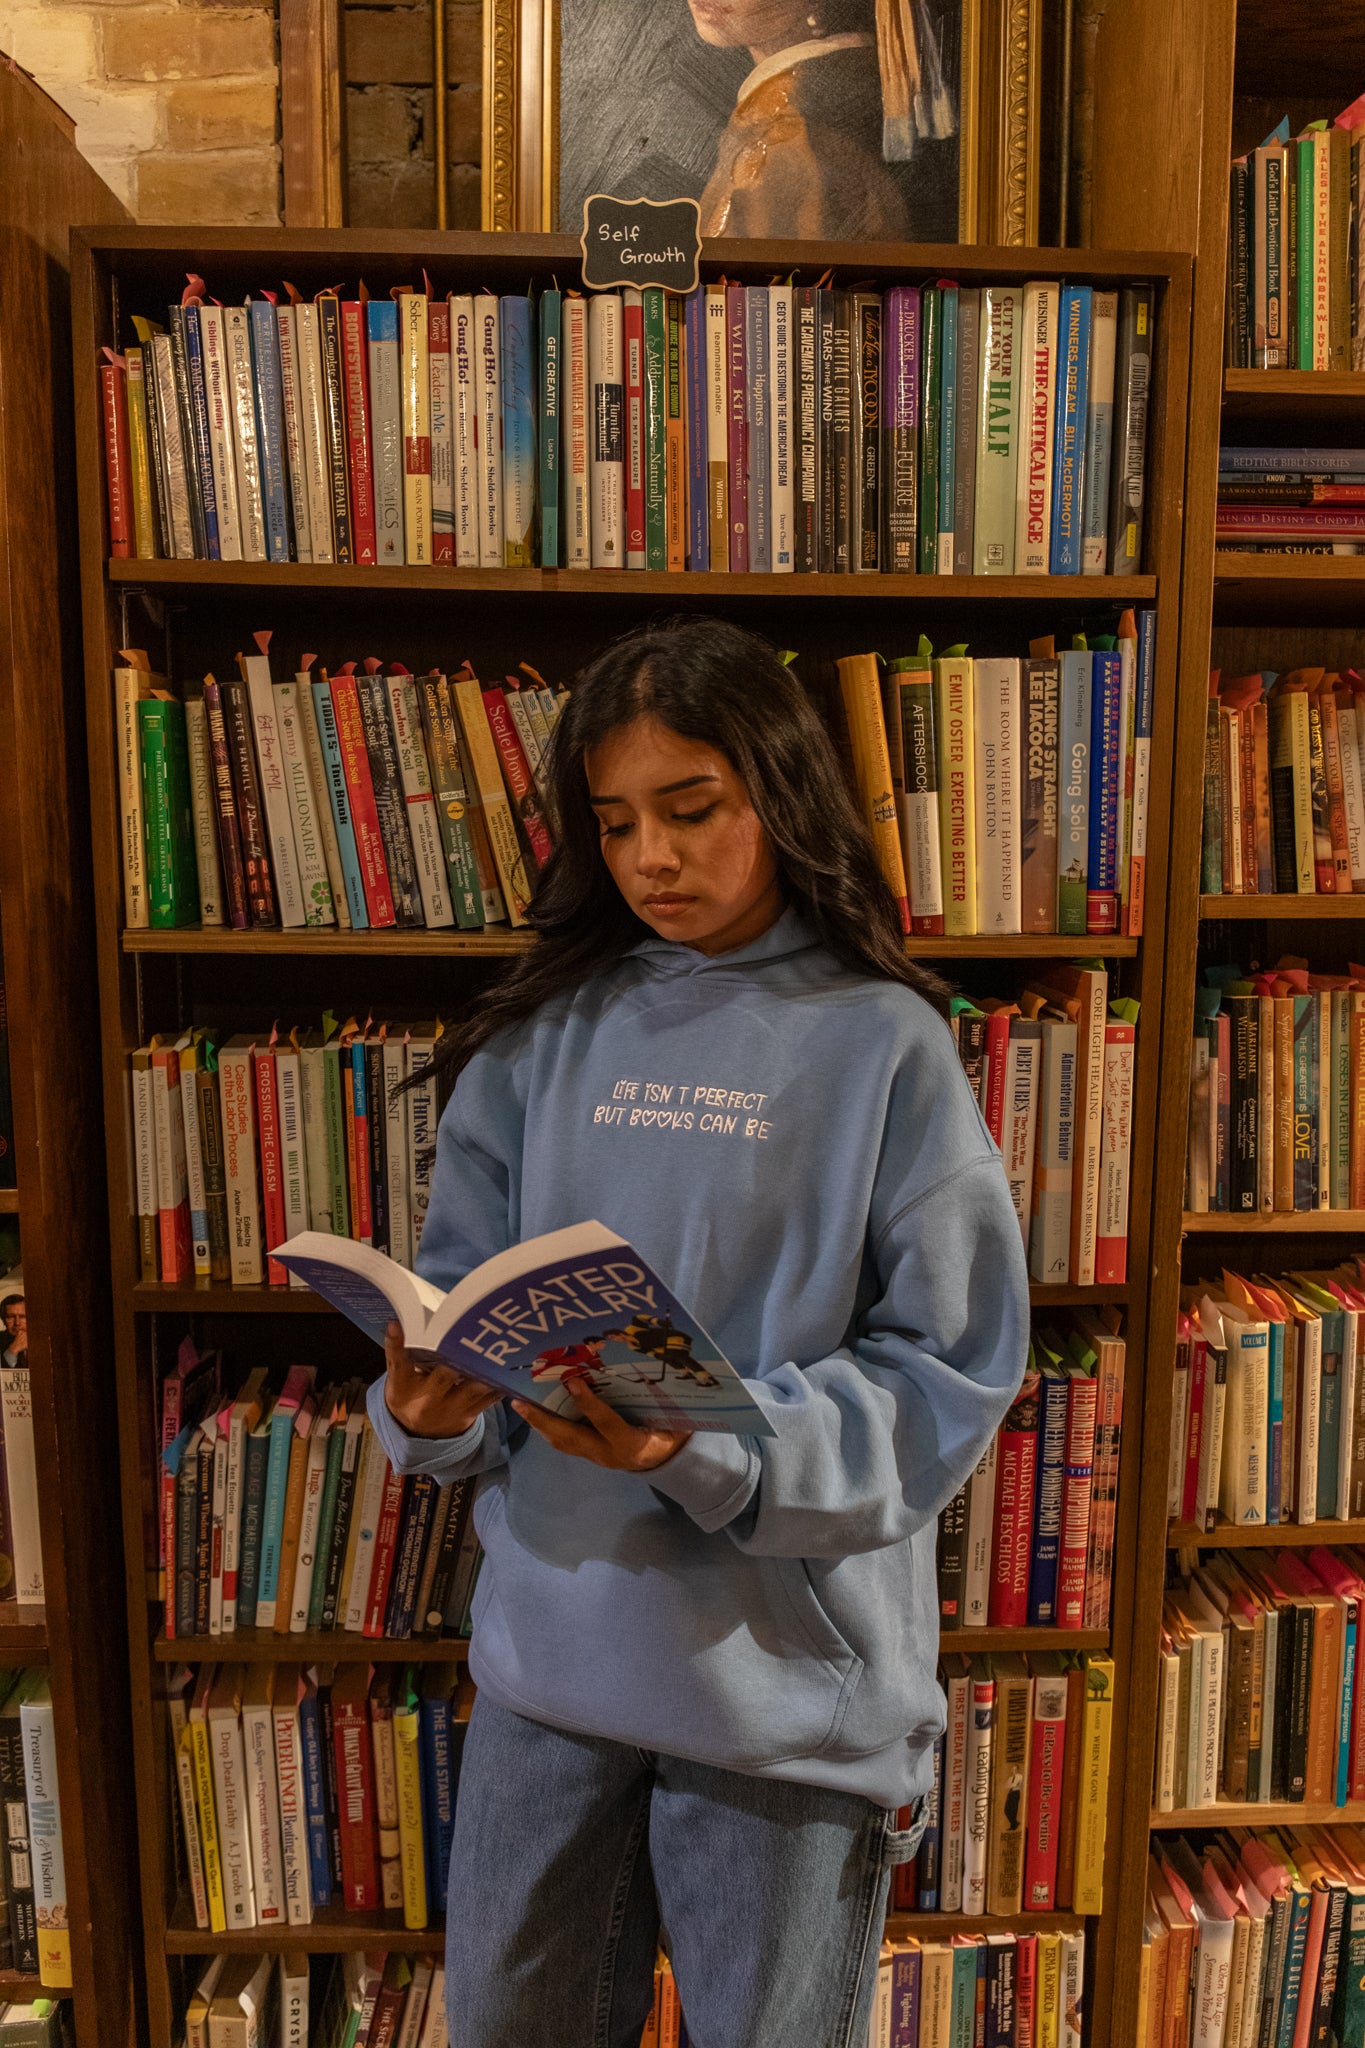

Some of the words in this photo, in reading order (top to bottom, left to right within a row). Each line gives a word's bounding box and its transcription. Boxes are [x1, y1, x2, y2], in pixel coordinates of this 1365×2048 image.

[1267, 163, 1279, 190] God's
[1268, 191, 1279, 216] Little
[599, 224, 640, 241] Self
[1268, 218, 1279, 268] Devotional
[620, 247, 685, 264] Growth
[1268, 270, 1279, 293] Book
[326, 316, 335, 333] The
[432, 317, 442, 342] Covey
[777, 301, 786, 323] CEO'S
[800, 307, 814, 324] THE
[864, 311, 880, 340] Think
[990, 302, 1001, 349] BILLS
[1002, 296, 1014, 328] CUT
[1036, 291, 1048, 344] WEISINGER
[1068, 300, 1080, 362] WINNERS
[207, 320, 219, 357] Siblings
[456, 314, 468, 355] Gung
[483, 315, 495, 355] Gung
[546, 337, 556, 358] GET
[754, 311, 763, 370] DELIVERING
[777, 325, 786, 347] GUIDE
[777, 349, 786, 358] TO
[801, 326, 815, 381] CAVEMAN'S
[864, 341, 879, 360] Like
[326, 336, 338, 377] Complete
[458, 357, 470, 385] Ho!
[485, 357, 496, 385] Ho!
[713, 331, 722, 382] teammates
[834, 329, 850, 381] CAPITAL
[990, 352, 1001, 371] IN
[1001, 331, 1013, 377] YOUR
[1034, 347, 1050, 389] THE
[210, 360, 221, 396] Without
[328, 379, 340, 407] Guide
[345, 312, 363, 439] BOOTSTRAPPING
[546, 362, 556, 417] CREATIVE
[777, 360, 786, 401] RESTORING
[1066, 366, 1077, 413] DREAM
[213, 398, 225, 430] Rivalry
[330, 409, 340, 417] to
[486, 392, 495, 410] Ken
[714, 385, 723, 416] matter.
[753, 374, 766, 426] Happiness
[777, 403, 787, 417] THE
[801, 383, 815, 441] PREGNANCY
[835, 387, 850, 433] GAINES
[864, 367, 878, 429] TYCOON
[432, 414, 444, 433] Me
[632, 421, 639, 437] MY
[987, 381, 1012, 457] HALF
[354, 442, 365, 470] YOUR
[547, 438, 555, 451] Lisa
[777, 420, 787, 458] AMERICAN
[1030, 391, 1048, 486] CRITICAL
[1064, 426, 1075, 453] BILL
[546, 453, 555, 470] Dyer
[778, 460, 787, 486] DREAM
[801, 444, 815, 502] COMPANION
[866, 446, 876, 490] GREENE
[335, 472, 347, 517] REPAIR
[357, 473, 368, 517] BUSINESS
[487, 466, 496, 502] Sheldon
[715, 481, 724, 519] Williams
[1060, 457, 1073, 538] McDERMOTT
[488, 505, 497, 536] Bowles
[1027, 489, 1044, 544] EDGE
[949, 674, 962, 714] EMILY
[1000, 677, 1010, 705] THE
[1029, 671, 1043, 700] LEE
[1044, 668, 1058, 746] TALKING
[488, 705, 511, 746] Scale
[502, 748, 527, 794] Down
[912, 704, 927, 794] AFTERSHOCK
[950, 719, 962, 762] OSTER
[1000, 711, 1010, 752] ROOM
[1029, 703, 1044, 780] IACOCCA
[983, 742, 995, 778] JOHN
[1067, 743, 1086, 797] Going
[1000, 759, 1011, 806] WHERE
[1043, 749, 1056, 838] STRAIGHT
[951, 771, 964, 847] EXPECTING
[985, 783, 996, 838] BOLTON
[1001, 811, 1012, 824] IT
[1070, 804, 1085, 842] Solo
[952, 851, 966, 902] BETTER
[1001, 831, 1012, 901] HAPPENED
[1093, 988, 1104, 1022] CORE
[1092, 1025, 1102, 1061] LIGHT
[1299, 1036, 1307, 1054] THE
[260, 1062, 273, 1122] CROSSING
[1059, 1053, 1074, 1118] Administrative
[1088, 1064, 1101, 1121] HEALING
[1299, 1056, 1307, 1101] GREATEST
[693, 1086, 768, 1112] PERFECT
[1299, 1104, 1307, 1112] IS
[263, 1125, 275, 1148] THE
[594, 1105, 626, 1125] BUT
[630, 1108, 695, 1130] BOOKS
[700, 1114, 738, 1134] CAN
[745, 1117, 773, 1140] BE
[1058, 1121, 1072, 1161] Behavior
[1295, 1114, 1310, 1160] LOVE
[264, 1151, 277, 1192] CHASM
[459, 1262, 647, 1354] HEATED
[483, 1283, 658, 1367] RIVALRY
[1044, 1385, 1068, 1464] REENGINEERING
[1069, 1385, 1097, 1464] REENGINEERING
[1001, 1449, 1017, 1510] MICHAEL
[1017, 1439, 1034, 1529] PRESIDENTIAL
[1038, 1467, 1063, 1537] MANAGEMENT
[1064, 1480, 1091, 1549] CORPORATION
[997, 1513, 1013, 1584] BESCHLOSS
[1013, 1533, 1029, 1594] COURAGE
[953, 1688, 965, 1719] FIRST,
[29, 1726, 44, 1785] Treasury
[219, 1731, 231, 1759] Drop
[276, 1719, 295, 1764] PETER
[953, 1722, 964, 1756] BREAK
[222, 1761, 234, 1788] Dead
[953, 1758, 963, 1775] ALL
[34, 1786, 46, 1799] of
[279, 1765, 298, 1814] LYNCH
[952, 1778, 962, 1797] THE
[30, 1800, 57, 1837] Wit
[223, 1790, 237, 1829] Healthy
[951, 1800, 961, 1832] RULES
[34, 1837, 51, 1849] &
[281, 1815, 298, 1853] Beating
[39, 1850, 55, 1899] Wisdom
[285, 1869, 299, 1899] Street
[1203, 1953, 1216, 1995] Someone
[1217, 1962, 1228, 1990] When
[1201, 1997, 1213, 2014] You
[1213, 2010, 1224, 2027] Lose
[1215, 1992, 1225, 2008] You
[1201, 2016, 1214, 2039] Love
